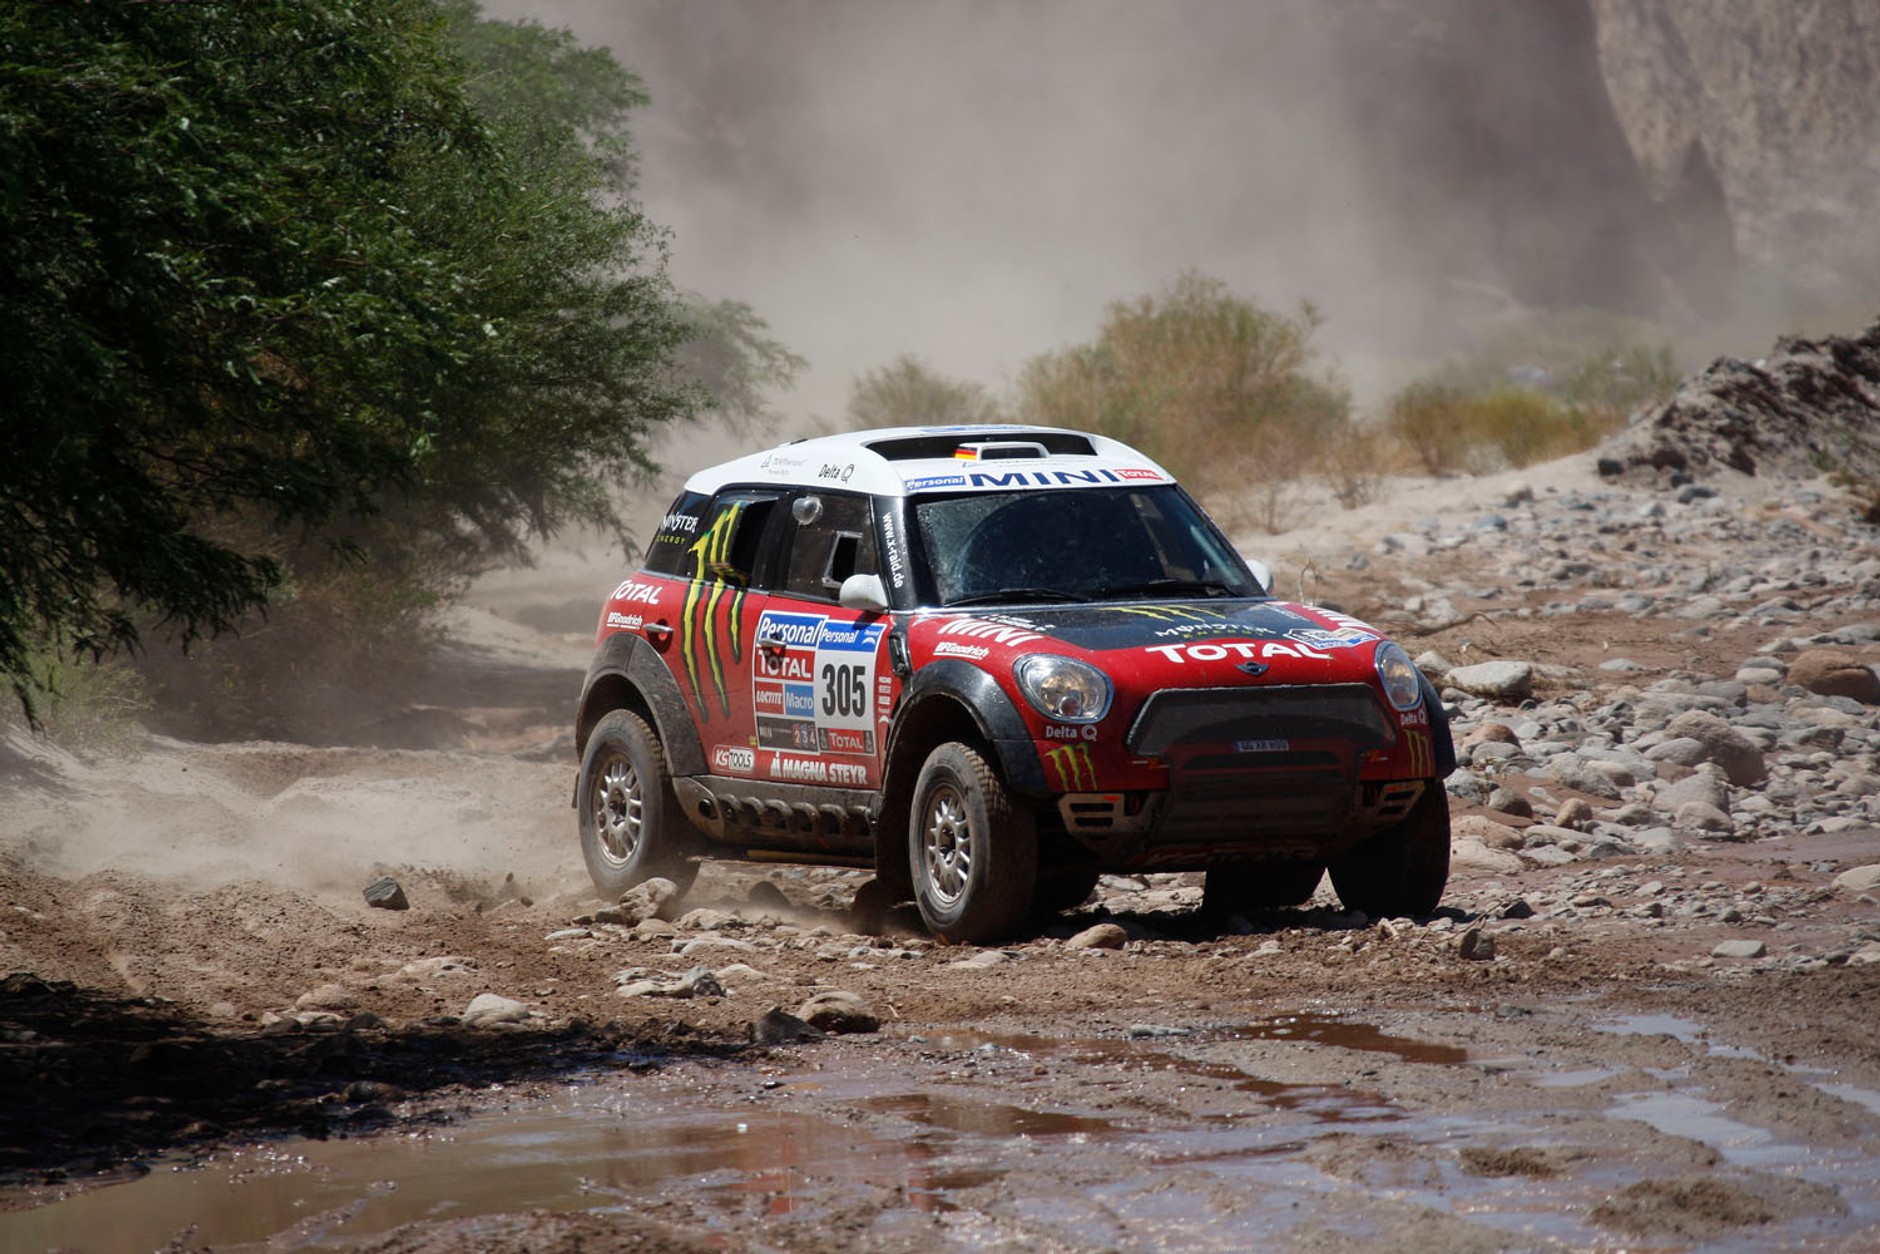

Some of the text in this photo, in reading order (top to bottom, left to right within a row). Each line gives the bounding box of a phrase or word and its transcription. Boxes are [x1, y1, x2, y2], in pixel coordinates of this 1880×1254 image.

[818, 464, 840, 479] Delta
[969, 469, 1121, 487] MINI
[906, 476, 964, 488] Personal
[882, 512, 905, 589] www.x-raid.de
[610, 580, 663, 605] TOTAL
[759, 617, 823, 644] Personal
[821, 628, 860, 643] Personal
[938, 618, 1044, 647] MINI
[936, 642, 990, 658] BFGoodrich
[1145, 643, 1333, 664] TOTAL
[759, 651, 812, 678] TOTAL
[756, 690, 782, 705] LOCTITE
[822, 664, 866, 718] 305
[786, 693, 814, 710] Macro
[829, 732, 864, 749] TOTAL
[1046, 725, 1098, 742] Delta Q
[783, 758, 868, 784] MAGNA STEYR
